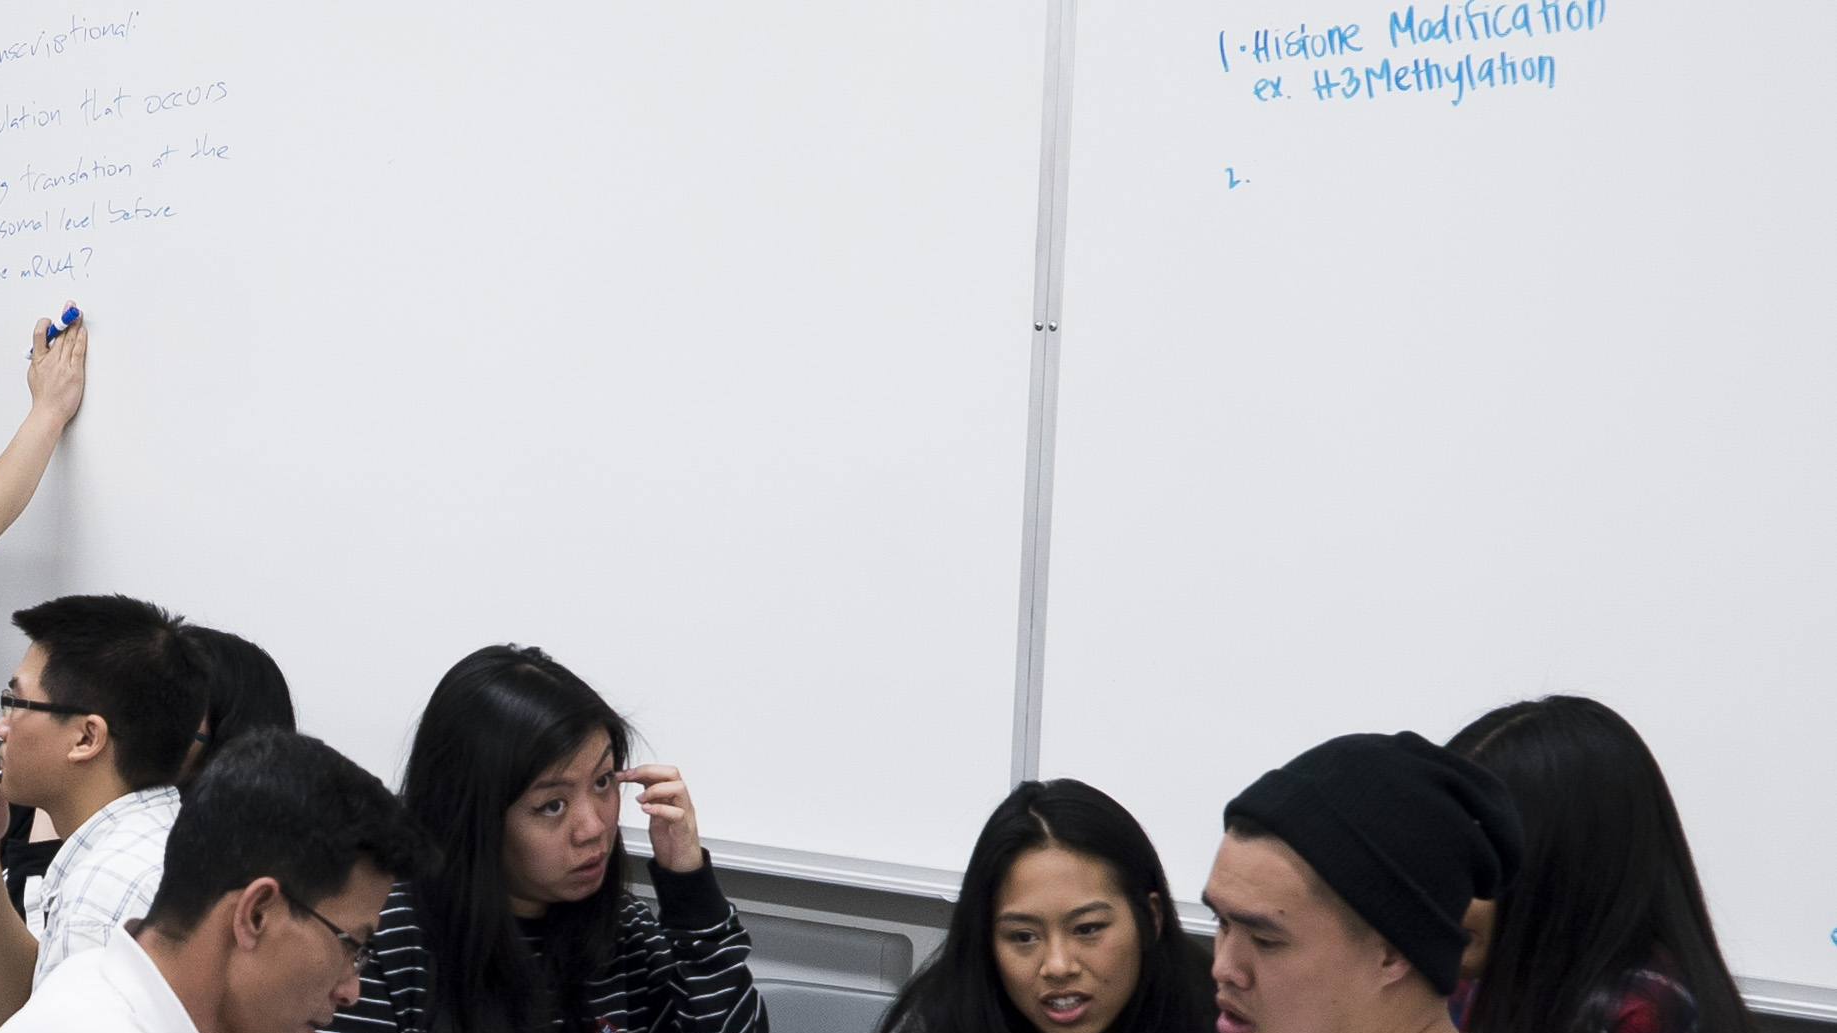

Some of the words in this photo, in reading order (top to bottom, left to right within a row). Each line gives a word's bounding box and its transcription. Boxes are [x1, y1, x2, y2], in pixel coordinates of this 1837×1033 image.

[1252, 23, 1364, 64] Histone
[1389, 0, 1607, 48] Modification
[80, 86, 132, 127] that
[144, 80, 228, 116] occurs
[20, 157, 132, 194] translation
[151, 145, 178, 170] at
[190, 133, 230, 161] the
[60, 201, 96, 231] level
[108, 197, 178, 224] before
